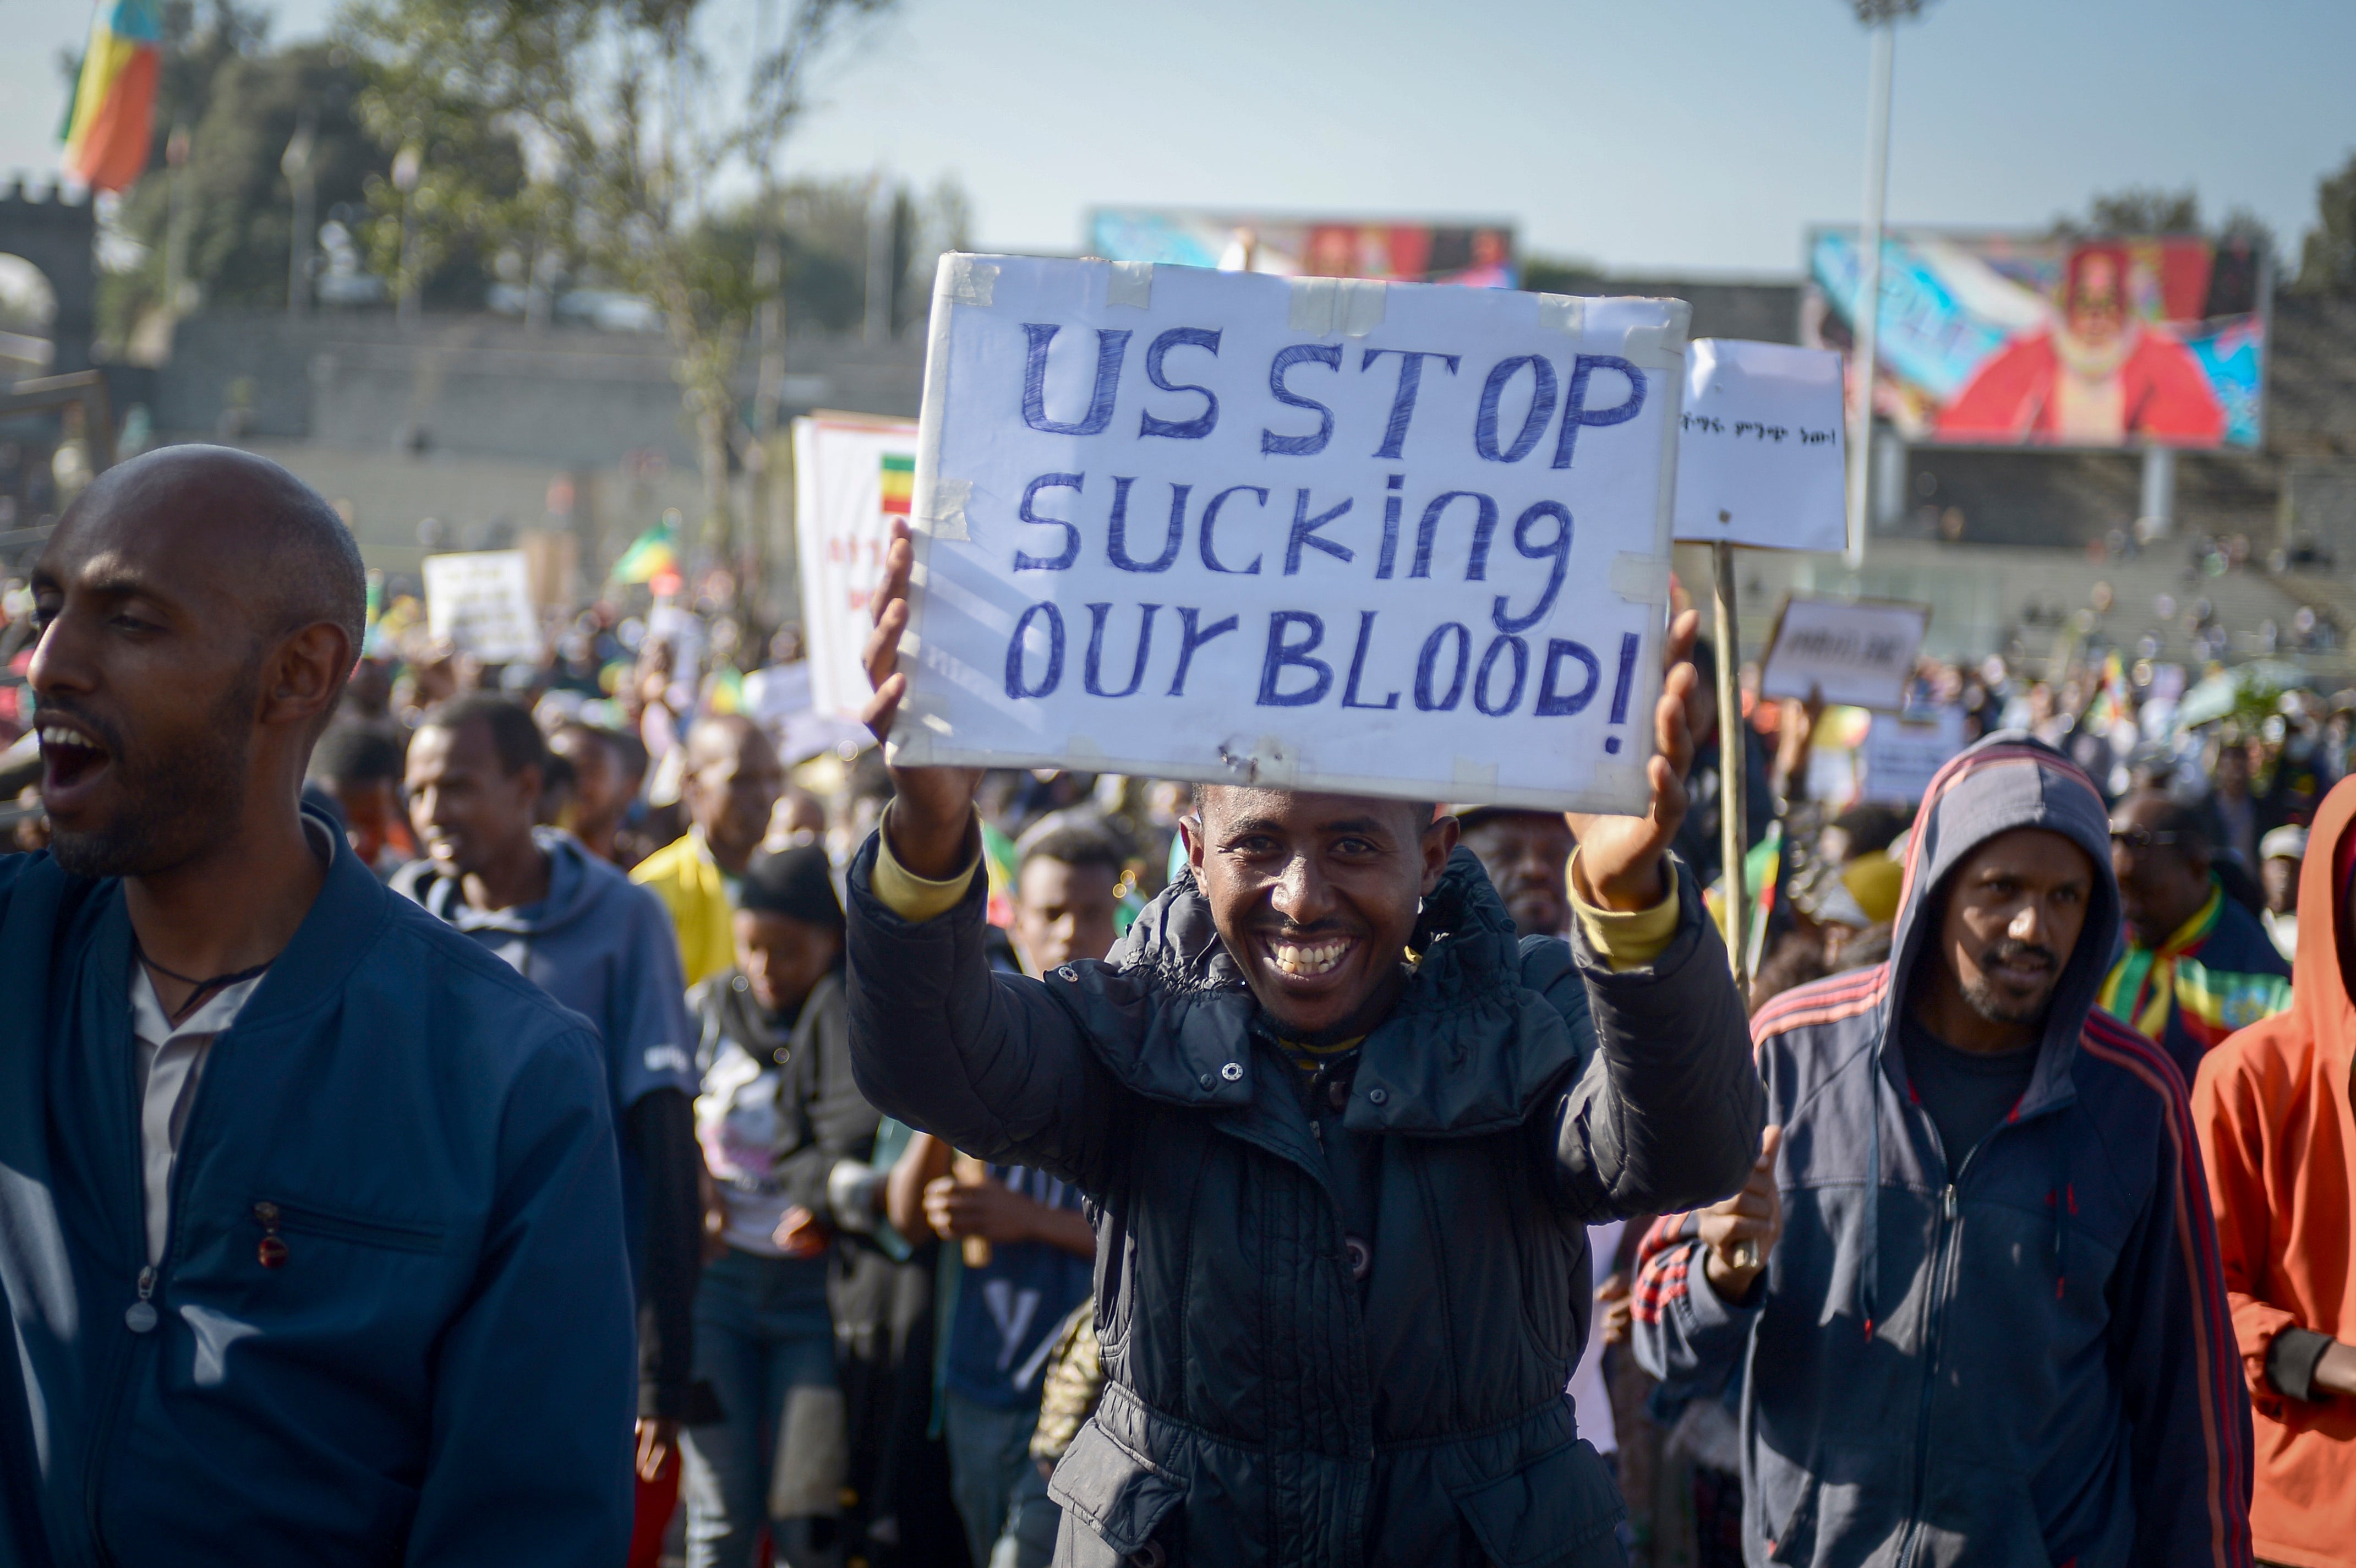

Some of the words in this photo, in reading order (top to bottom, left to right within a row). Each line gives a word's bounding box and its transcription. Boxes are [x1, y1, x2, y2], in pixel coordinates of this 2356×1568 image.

[1018, 321, 1224, 440] US
[1260, 342, 1648, 470] STOP
[1255, 610, 1642, 756] BLOOD!
